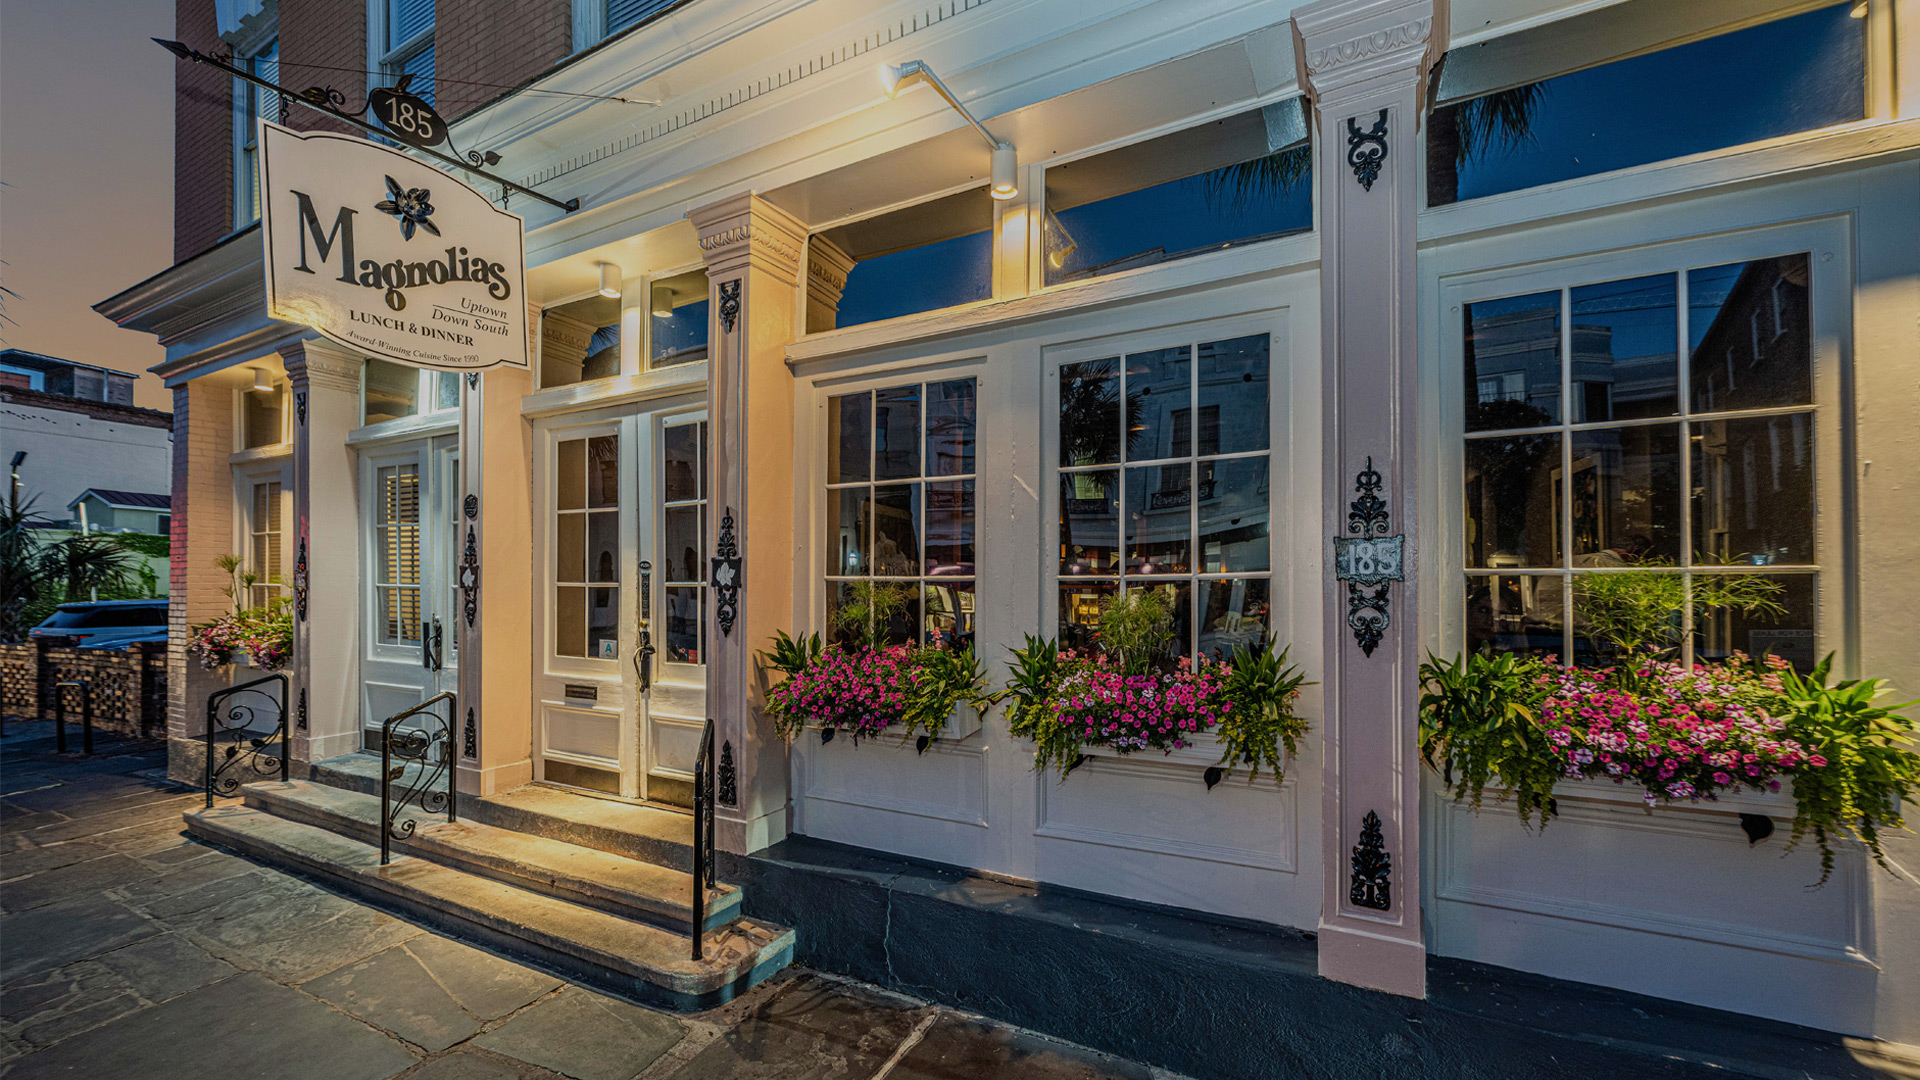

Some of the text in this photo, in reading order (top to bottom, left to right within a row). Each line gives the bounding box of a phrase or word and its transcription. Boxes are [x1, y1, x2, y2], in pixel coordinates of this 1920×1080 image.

[385, 97, 432, 139] 185
[290, 189, 511, 312] Magnolias
[432, 308, 509, 337] Down South
[461, 297, 508, 320] Uptown
[349, 309, 474, 347] LUNCH & DINNER
[346, 330, 479, 363] Award-Winning Cuisine Since 1990
[1348, 542, 1397, 575] 185
[605, 643, 612, 653] A
